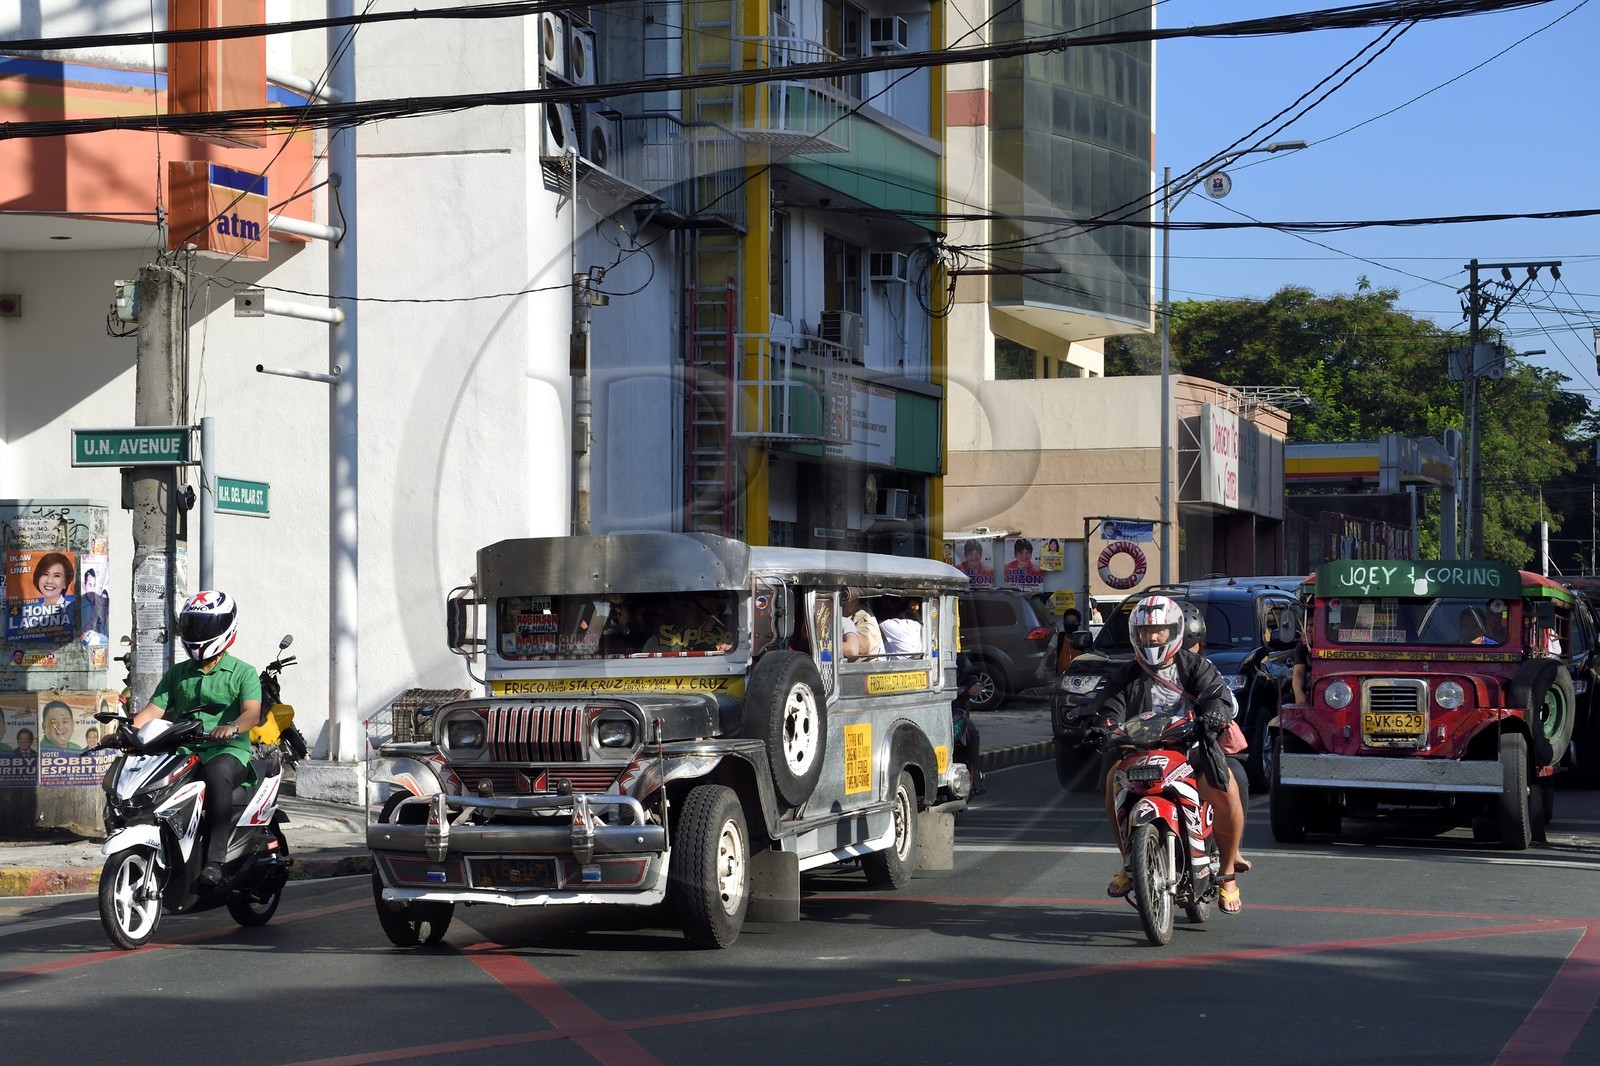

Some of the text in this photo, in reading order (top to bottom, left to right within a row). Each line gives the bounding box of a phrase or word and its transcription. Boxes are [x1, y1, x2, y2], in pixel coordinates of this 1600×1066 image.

[217, 213, 260, 241] atm
[84, 438, 180, 455] U.N. AVENUE
[231, 487, 240, 502] DEL
[241, 488, 256, 504] PILAR
[10, 554, 32, 562] IKAW
[1006, 575, 1041, 583] HIZON
[1340, 567, 1397, 585] JOEY
[1425, 567, 1500, 587] CORING
[10, 603, 69, 617] 4 HONEY
[533, 602, 550, 610] 2013
[9, 614, 71, 629] LACUNA
[517, 615, 557, 625] ROBINSON
[515, 634, 554, 645] MABINI
[504, 683, 544, 694] FRISCO
[690, 677, 729, 690] CRUZ
[1365, 715, 1422, 727] PVK 629
[42, 757, 99, 766] BOBBY
